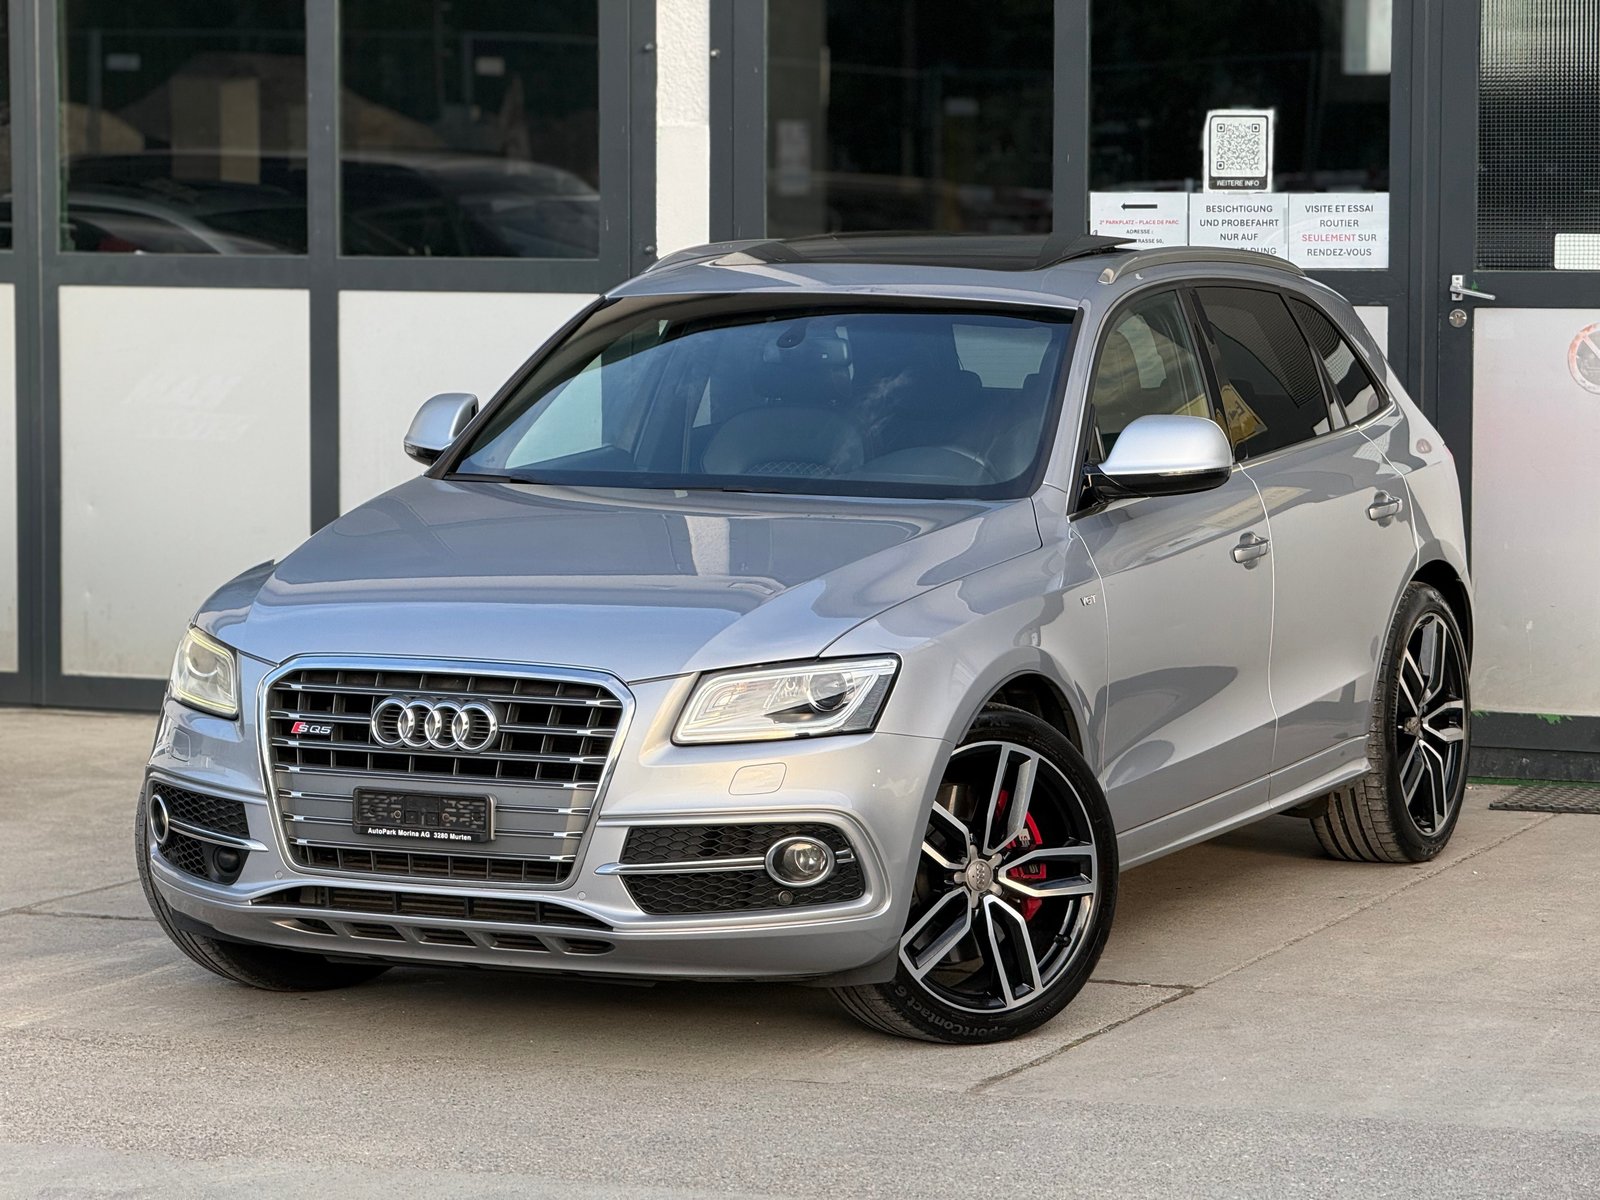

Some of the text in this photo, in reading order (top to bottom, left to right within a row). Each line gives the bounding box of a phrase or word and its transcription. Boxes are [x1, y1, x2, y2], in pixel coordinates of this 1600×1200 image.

[1244, 179, 1260, 187] INFO
[1205, 204, 1273, 213] BESICHTIGUNG
[1304, 204, 1374, 213] VISITE ET ESSAI
[1199, 219, 1279, 227] UND PROBEFAHRT
[1319, 219, 1359, 228] ROUTIER
[1219, 233, 1259, 241] NUR AUF
[1301, 233, 1377, 242] SEULEMENT SUR
[1306, 248, 1372, 256] RENDEZ-VOUS
[297, 724, 332, 734] SQ5
[367, 827, 397, 836] AutoPark
[398, 829, 419, 837] Morina
[449, 832, 472, 841] Murten
